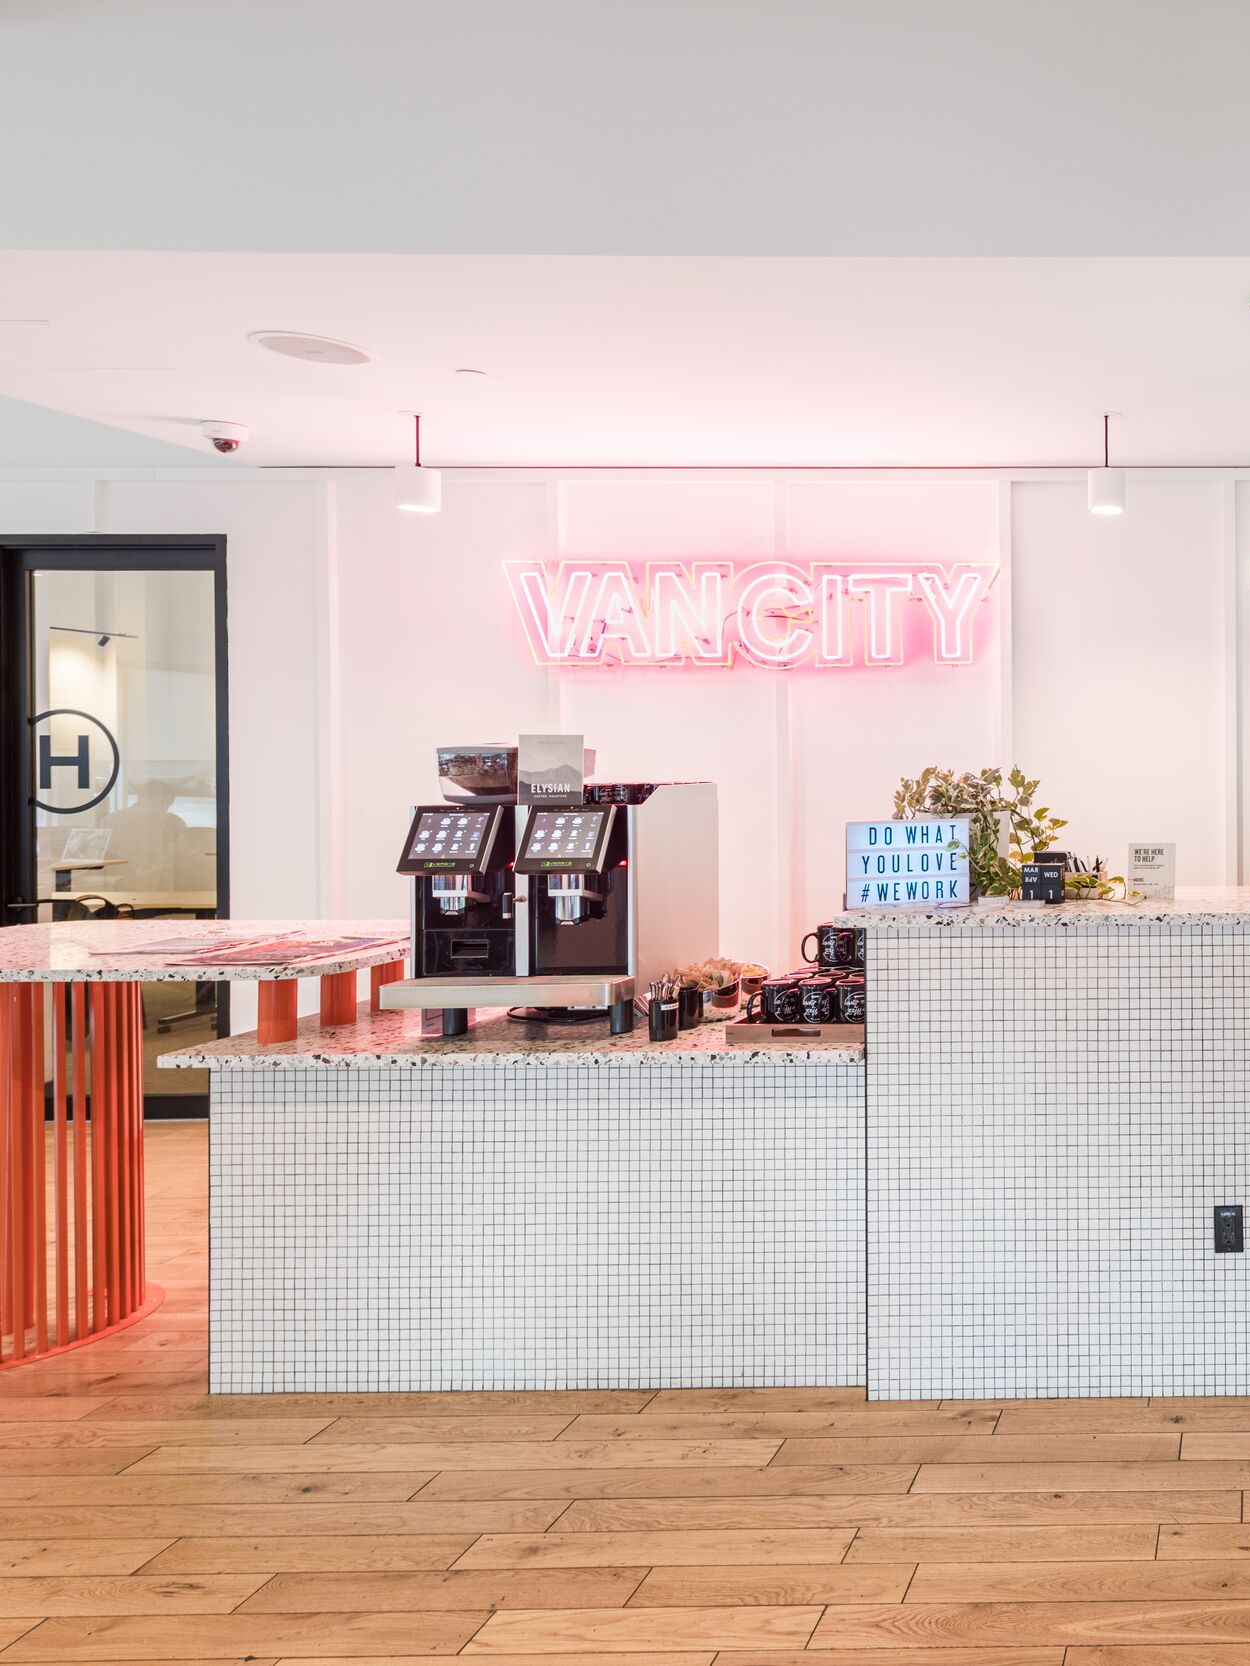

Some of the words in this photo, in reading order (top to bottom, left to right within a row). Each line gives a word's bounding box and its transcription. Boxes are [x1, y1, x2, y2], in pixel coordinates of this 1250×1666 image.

[40, 735, 90, 789] H
[531, 783, 570, 793] ELYSIAN
[869, 827, 892, 846] DO
[905, 824, 957, 845] WHAT
[861, 880, 958, 902] #WEWORK
